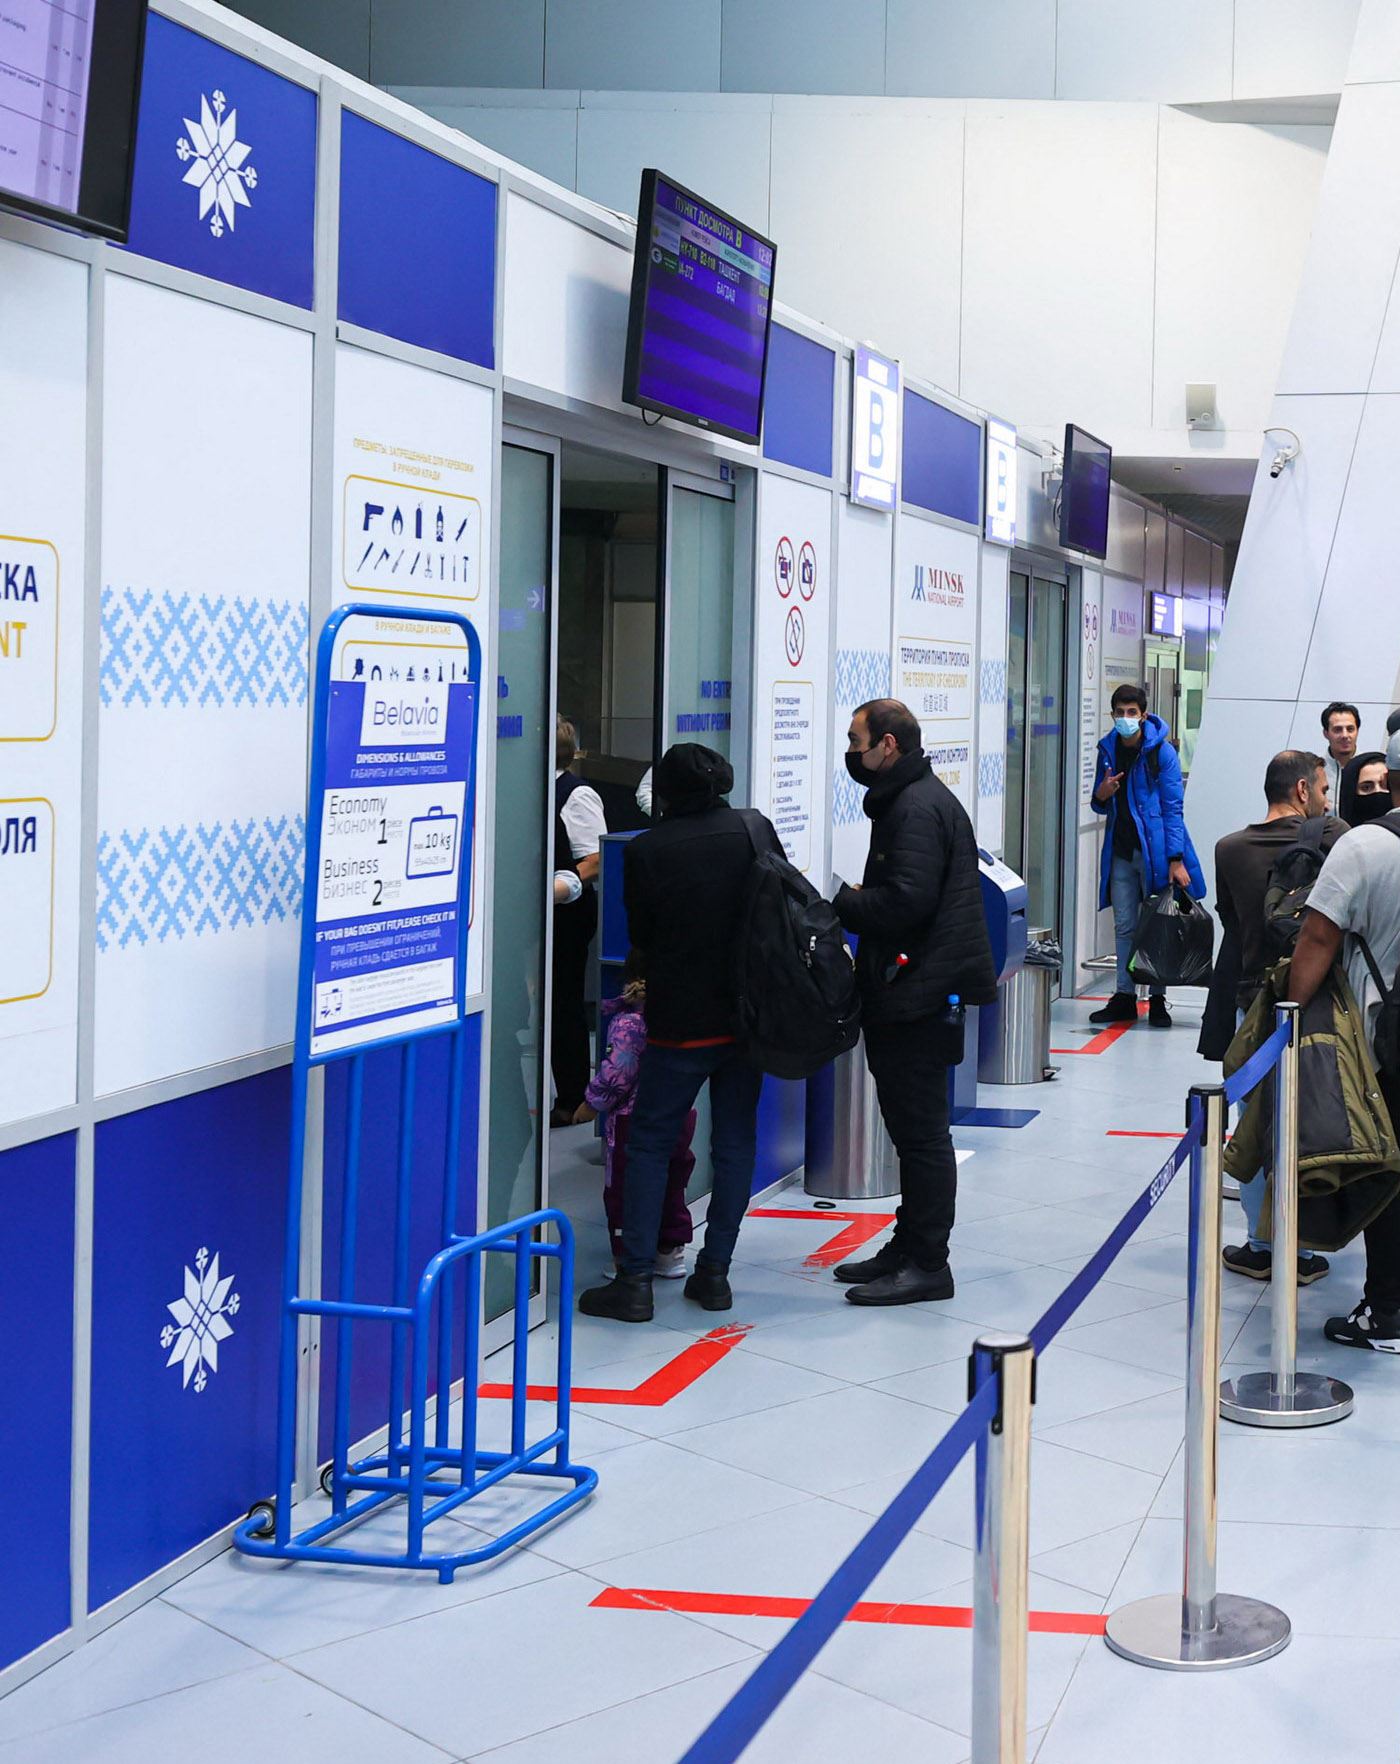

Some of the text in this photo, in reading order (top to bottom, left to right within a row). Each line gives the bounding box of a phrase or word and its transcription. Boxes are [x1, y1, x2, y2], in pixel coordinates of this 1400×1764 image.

[868, 390, 884, 469] B
[0, 562, 38, 602] КА
[928, 567, 964, 594] MINSK
[373, 696, 439, 726] Belavia
[356, 752, 399, 764] DIMENSIONS
[404, 751, 446, 763] ALLOWANCES
[330, 795, 388, 816] Economy
[0, 816, 37, 854] ЛЯ
[328, 816, 388, 844] Эконом 1
[425, 833, 438, 849] 10
[440, 832, 451, 850] kg
[324, 857, 379, 879] Business
[323, 879, 383, 906] Бизнес 2
[324, 928, 344, 940] YOUR
[344, 926, 358, 938] BAG
[421, 913, 442, 926] CHECK
